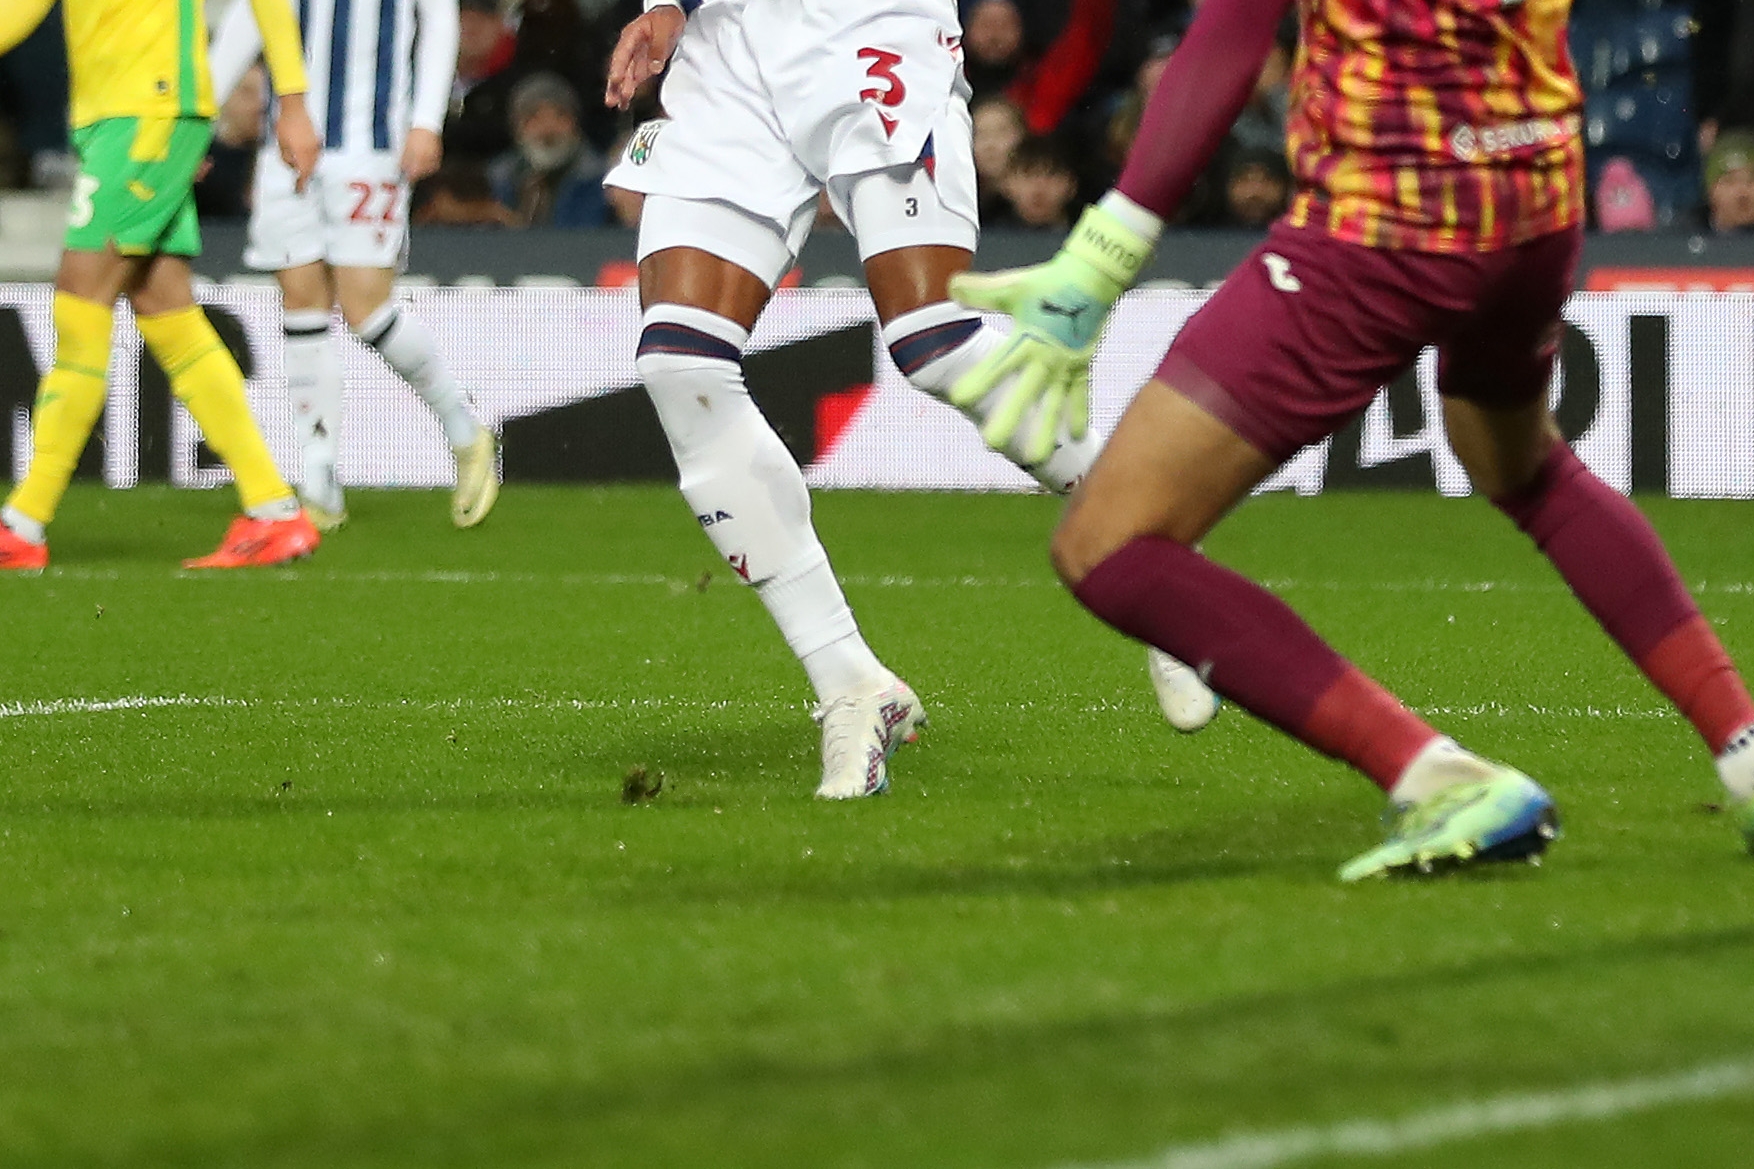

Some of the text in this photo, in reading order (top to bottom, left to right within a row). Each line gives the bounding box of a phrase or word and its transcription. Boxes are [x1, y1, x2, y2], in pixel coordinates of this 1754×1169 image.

[857, 47, 907, 108] 3
[904, 197, 919, 218] 3
[696, 510, 735, 527] BA
